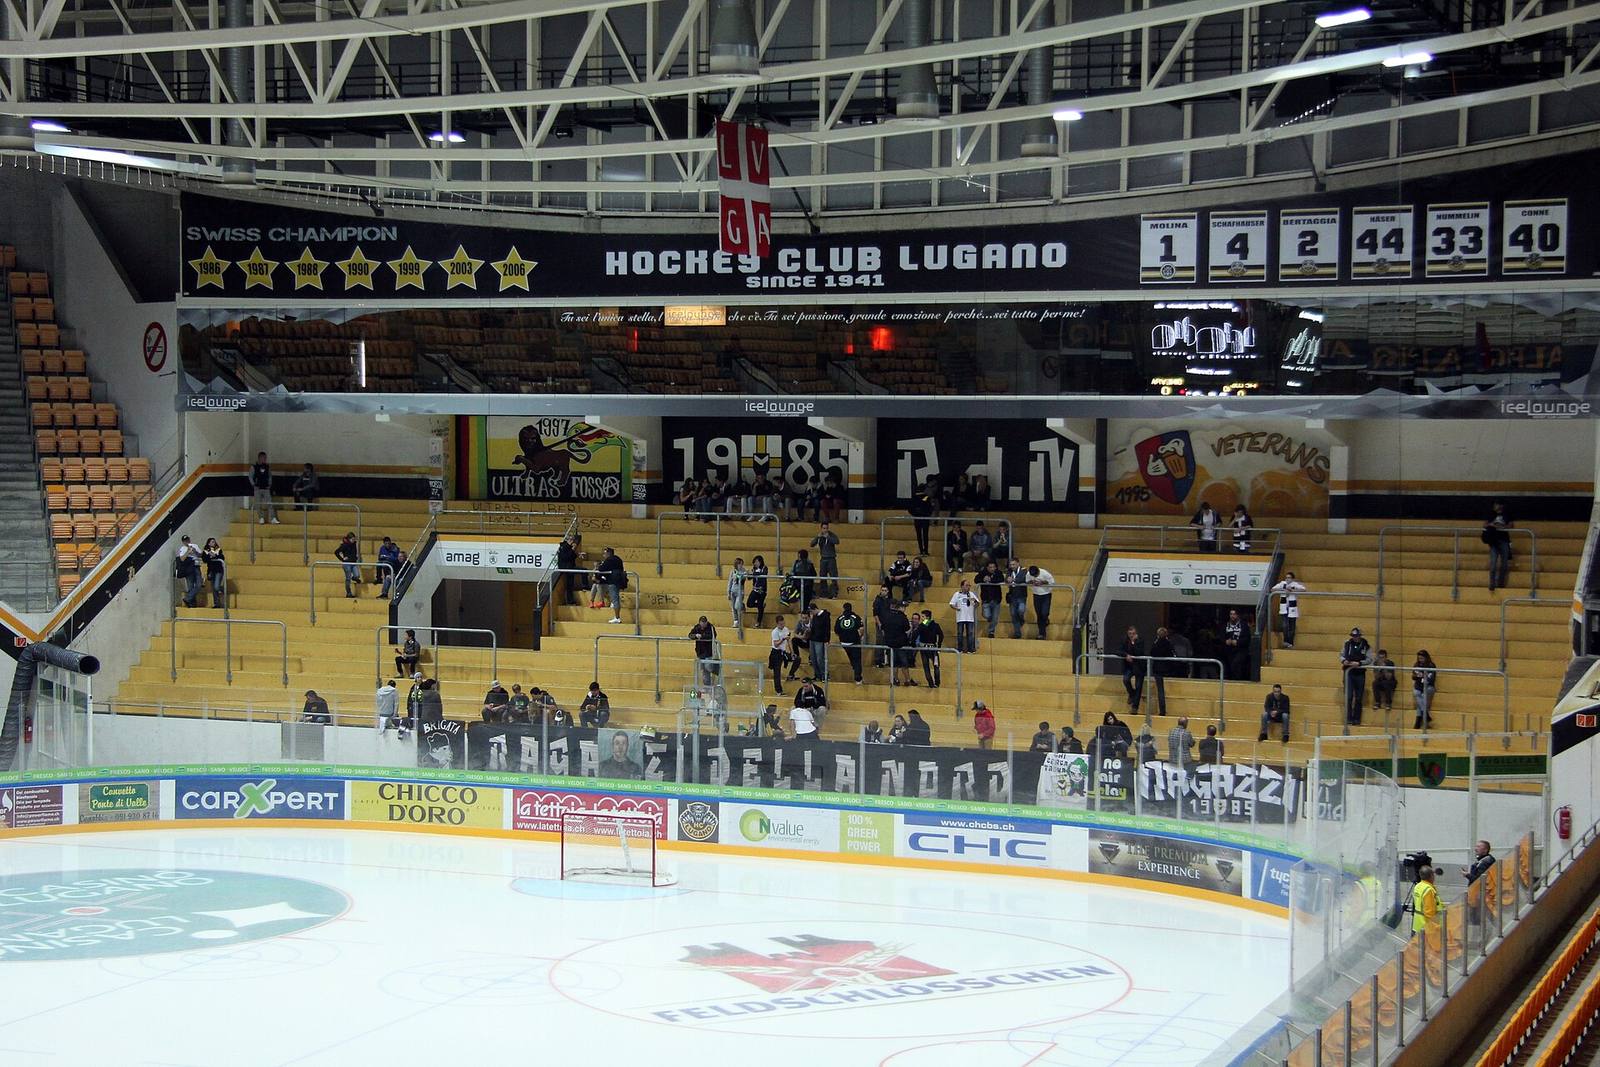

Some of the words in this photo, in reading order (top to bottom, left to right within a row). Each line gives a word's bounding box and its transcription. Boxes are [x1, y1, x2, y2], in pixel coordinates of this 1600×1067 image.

[1436, 212, 1480, 221] NUMMELIN
[1521, 208, 1550, 217] CONNE
[1149, 221, 1189, 230] MOLINA
[1282, 217, 1337, 226] BERTAGGIA
[186, 226, 261, 241] SWISS
[268, 226, 398, 242] CHAMPION
[1356, 227, 1404, 256] 44
[1431, 225, 1484, 256] 33
[1508, 222, 1561, 253] 40
[1159, 234, 1177, 263] 1
[1226, 232, 1250, 261] 4
[1297, 230, 1319, 257] 2
[605, 249, 761, 276] HOCKEY
[777, 246, 881, 274] CLUB
[899, 242, 1067, 271] LUGANO
[199, 262, 221, 275] 1986
[248, 262, 269, 276] 1987
[297, 263, 318, 276] 1988
[348, 263, 369, 276] 1990
[398, 262, 420, 275] 1999
[450, 262, 473, 275] 2003
[502, 263, 526, 277] 2006
[745, 275, 817, 288] SINCE
[824, 274, 885, 288] 1941
[186, 395, 247, 410] icelounge
[745, 399, 815, 415] icelounge
[1501, 400, 1590, 416] icelounge
[535, 418, 571, 437] 1997
[1210, 431, 1331, 484] VETERANS
[491, 475, 561, 498] ULTRAS
[1114, 485, 1151, 505] 1995
[445, 551, 480, 566] amag
[507, 553, 542, 568] amag
[1119, 571, 1161, 587] amag
[1194, 573, 1237, 589] amag
[422, 719, 461, 736] BRIGATA
[1103, 758, 1122, 770] no
[707, 745, 856, 793] DELLA
[880, 759, 1011, 803] NORD
[378, 782, 478, 806] CHICCO
[388, 804, 466, 826] D'ORO
[847, 827, 878, 839] GREEN
[940, 818, 1015, 832] www.chcbs.ch
[847, 840, 881, 852] POWER
[908, 832, 1047, 861] CHC
[1125, 840, 1150, 857] THE
[1153, 845, 1209, 866] PREMIUM
[1137, 860, 1201, 880] EXPERIENCE
[0, 877, 214, 906] UGANO
[652, 964, 1116, 1023] FELDSCHLÖSSCHEN
